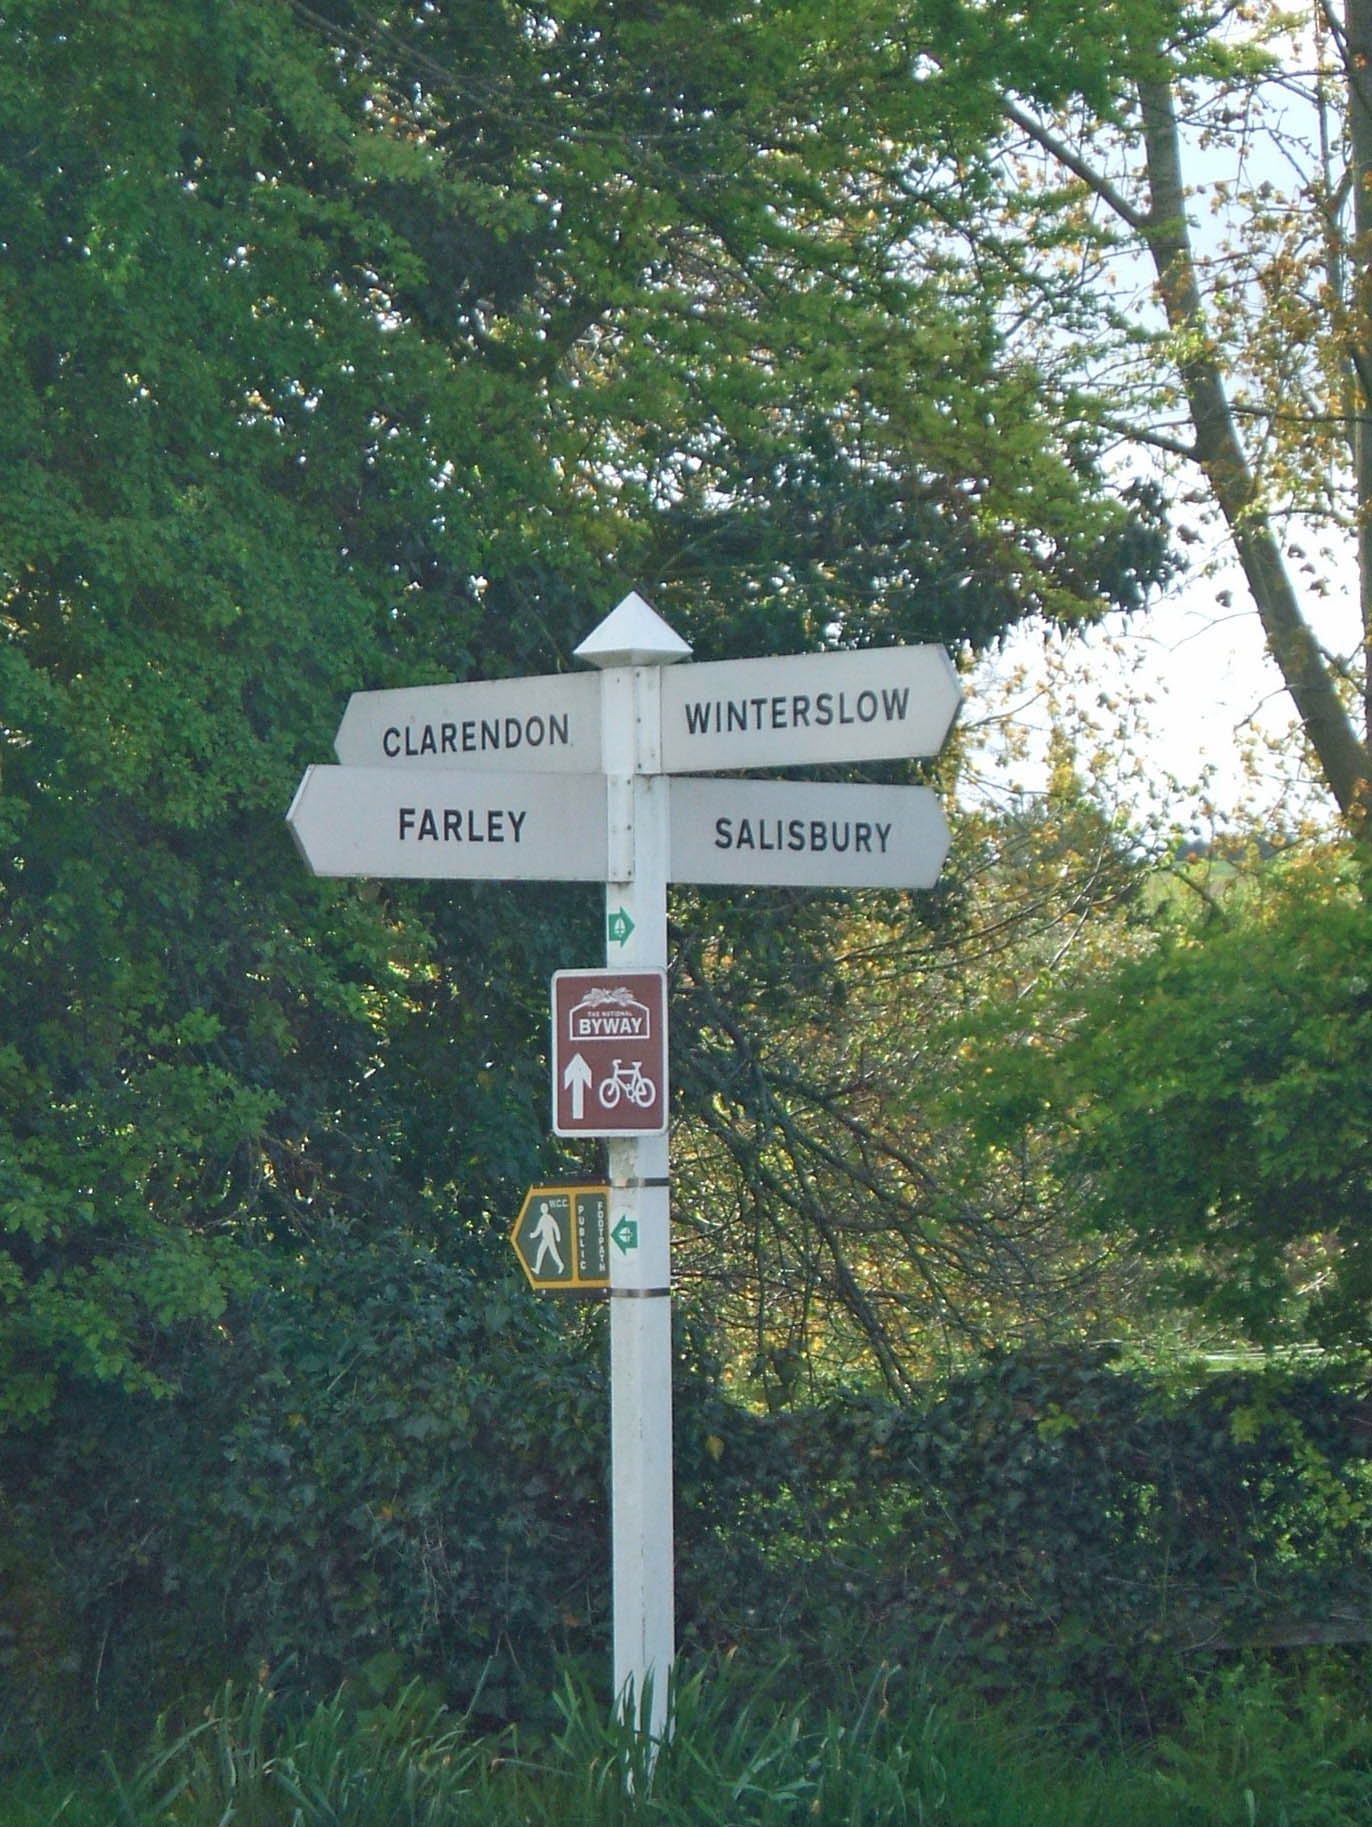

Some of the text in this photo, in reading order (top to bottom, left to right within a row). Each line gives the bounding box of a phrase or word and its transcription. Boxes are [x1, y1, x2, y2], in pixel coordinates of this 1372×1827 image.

[685, 687, 910, 736] WINTERSLOW
[382, 713, 570, 758] CLARENDON
[398, 807, 527, 843] FARLEY
[715, 817, 893, 853] SALISBURY
[579, 1017, 643, 1035] BYWAY
[577, 1205, 587, 1270] PUBLIC
[597, 1201, 606, 1271] FOOTPATH
